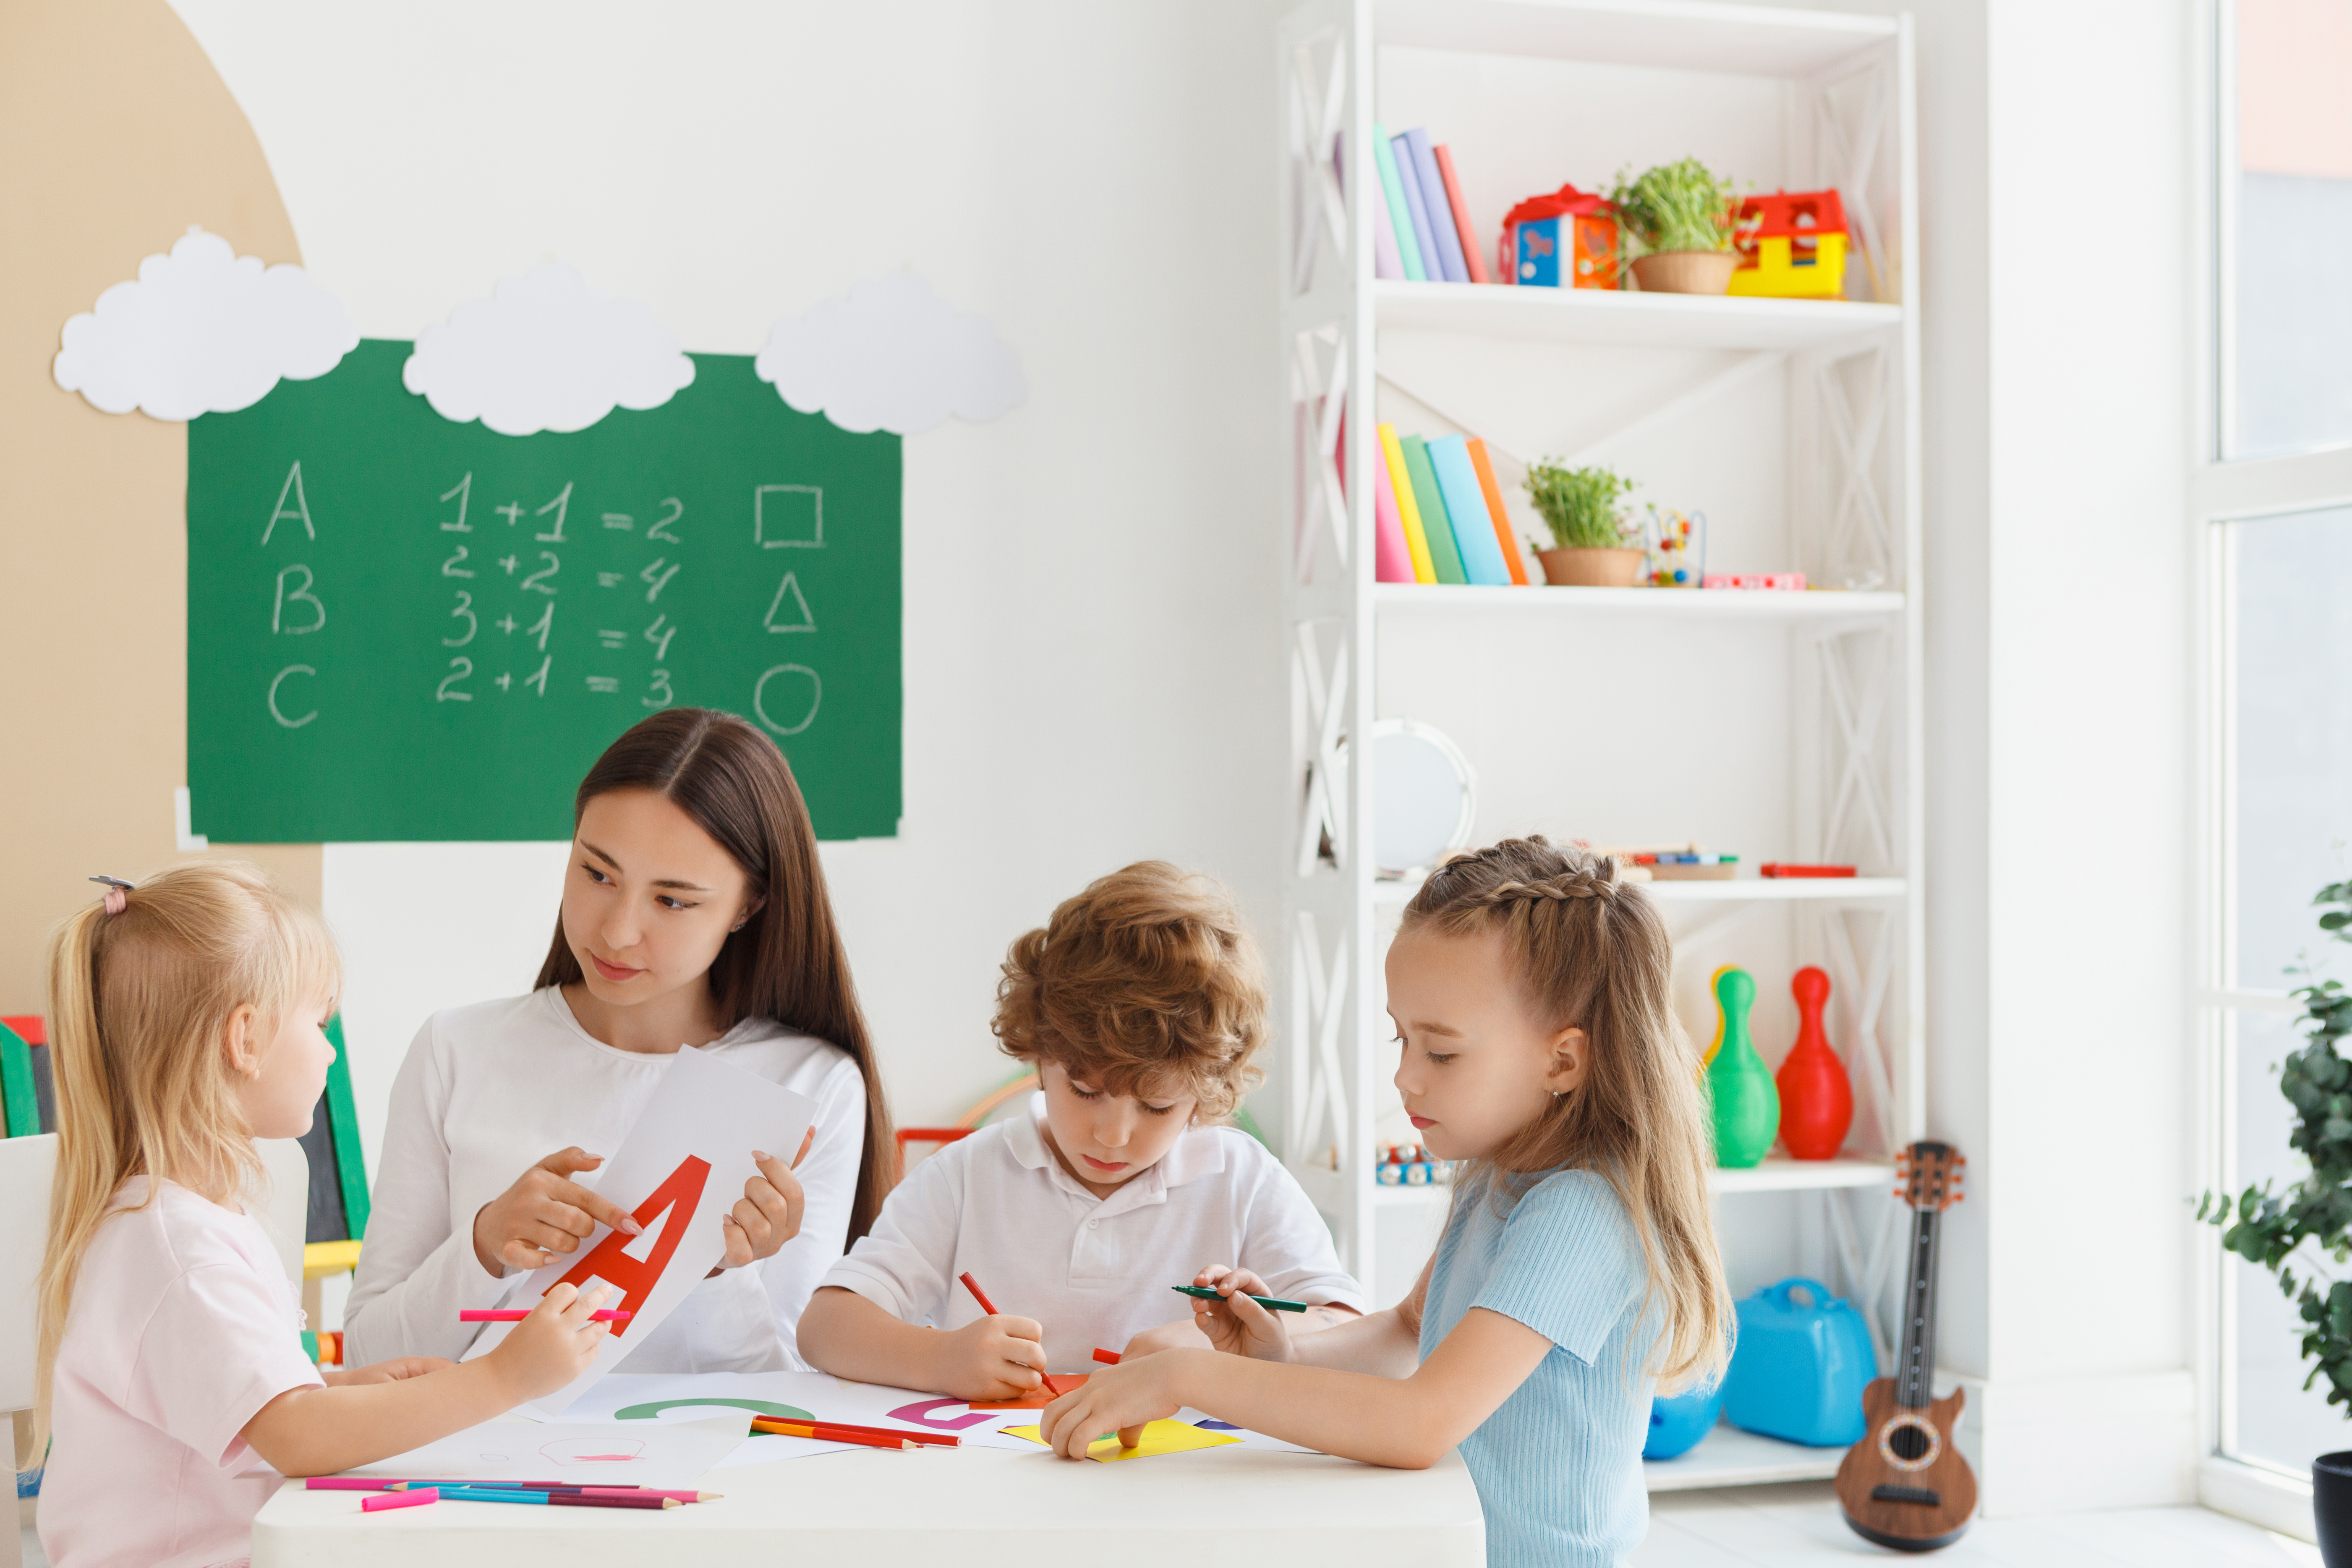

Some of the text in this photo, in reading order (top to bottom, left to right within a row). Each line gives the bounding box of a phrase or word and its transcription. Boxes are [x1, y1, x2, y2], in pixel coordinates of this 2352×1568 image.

[261, 460, 315, 546] A
[440, 471, 473, 532] 1
[535, 481, 574, 542] 1
[646, 497, 684, 544] 2
[272, 564, 326, 634] B
[441, 545, 475, 578] 2
[640, 557, 680, 603] 4
[442, 590, 477, 647] 3
[644, 613, 677, 661] 4
[268, 664, 318, 728] C
[436, 656, 473, 702] 2
[641, 669, 674, 707] 3
[541, 1154, 711, 1338] A
